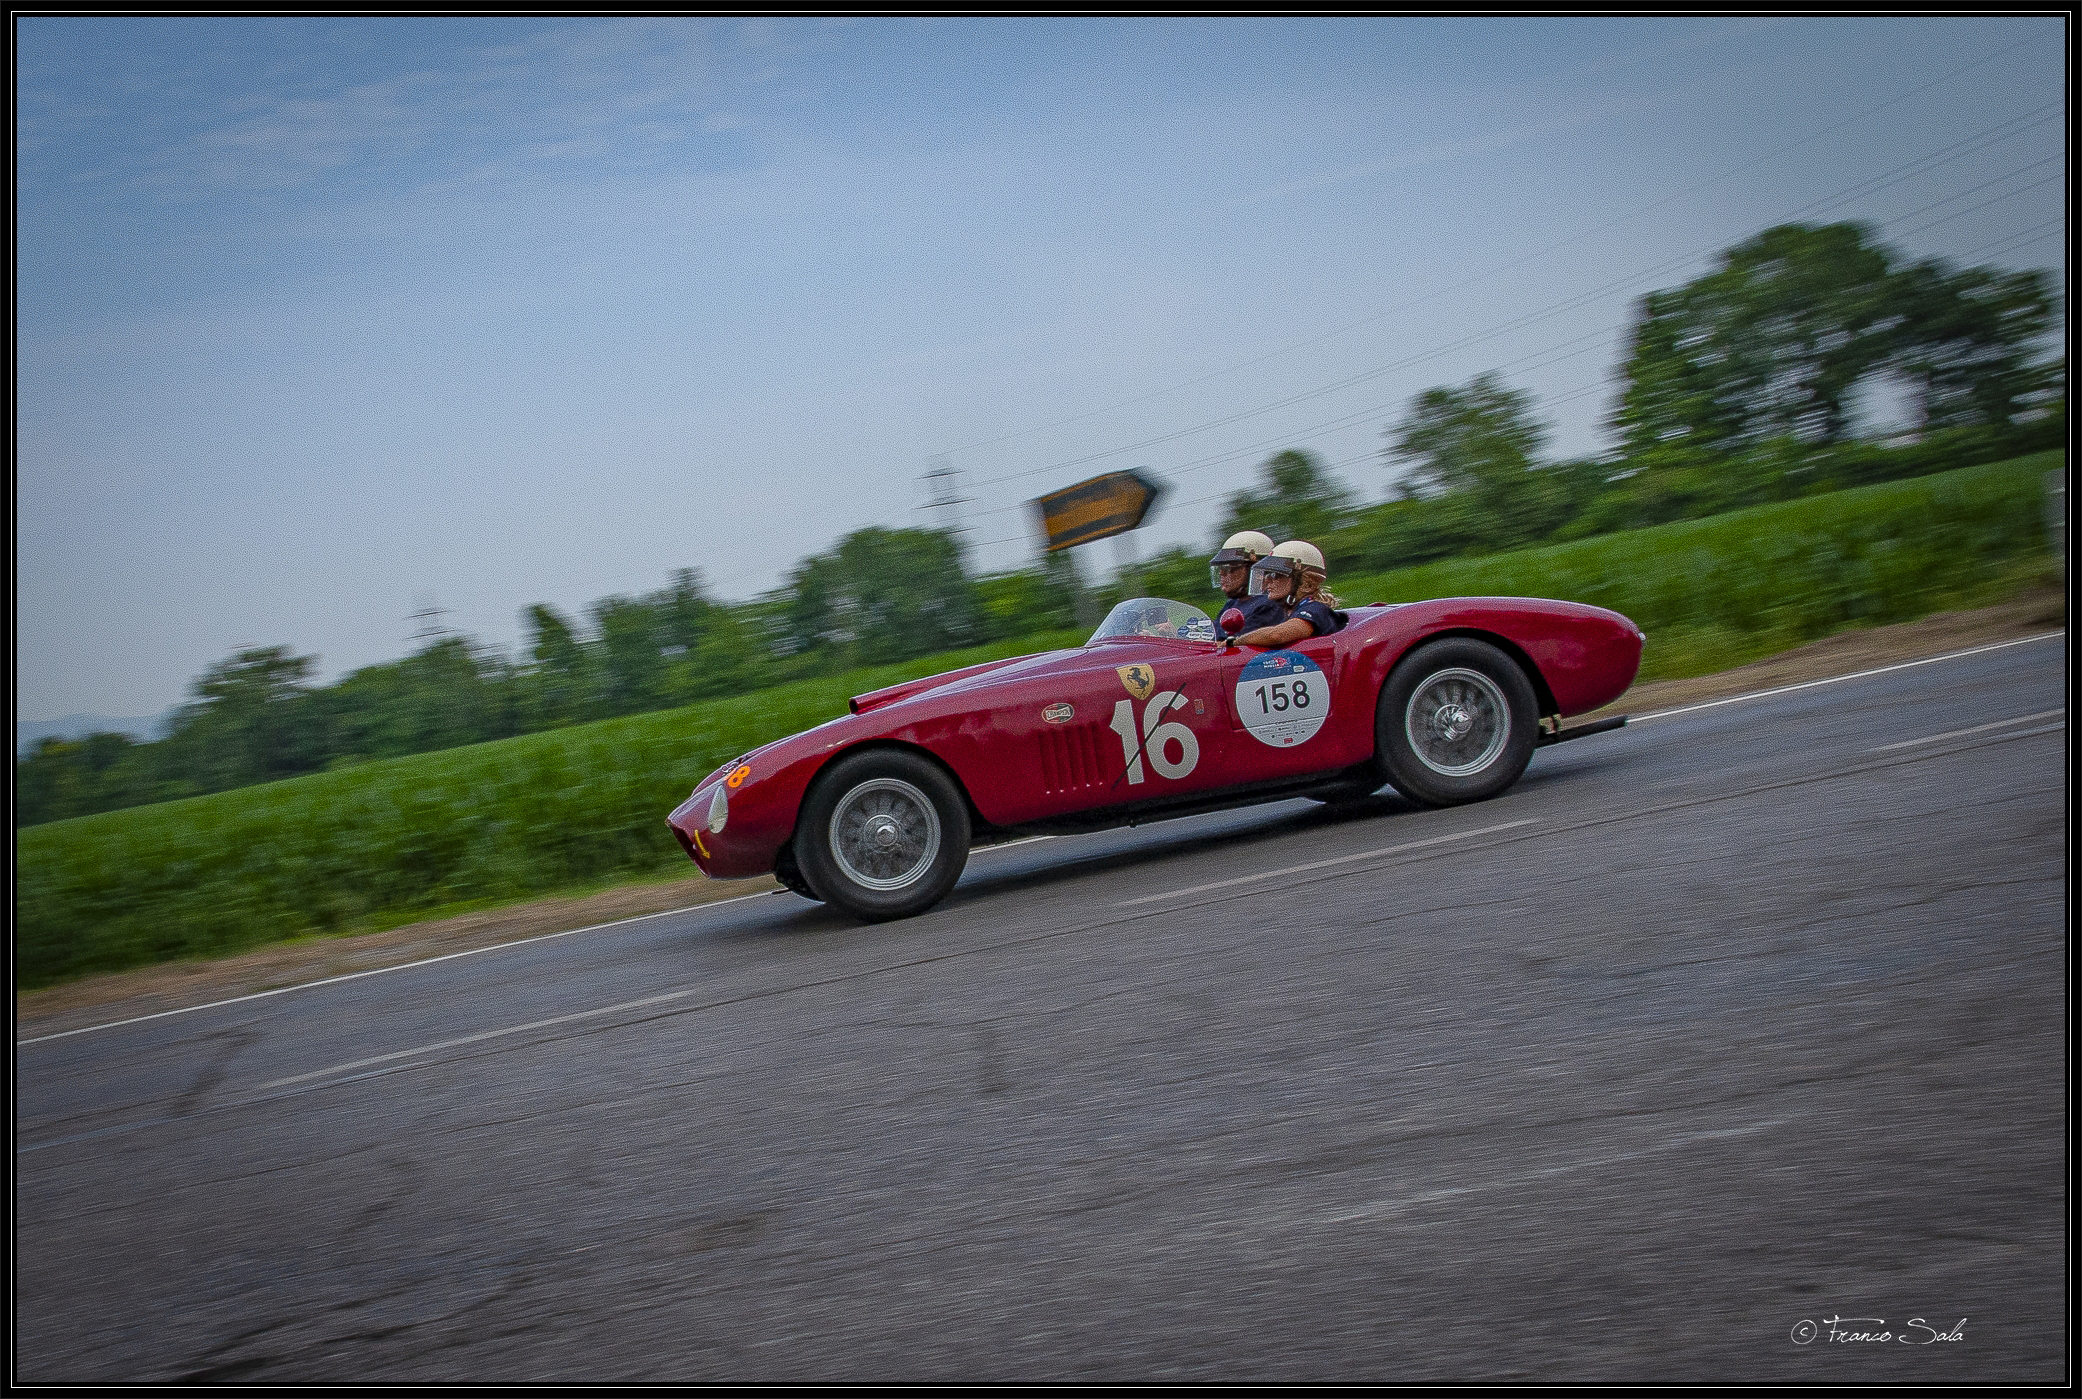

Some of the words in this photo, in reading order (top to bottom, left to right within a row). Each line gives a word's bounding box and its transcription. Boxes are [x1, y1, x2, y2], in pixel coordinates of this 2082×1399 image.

[1255, 680, 1311, 714] 158
[1109, 691, 1199, 785] 16
[723, 763, 751, 788] 8
